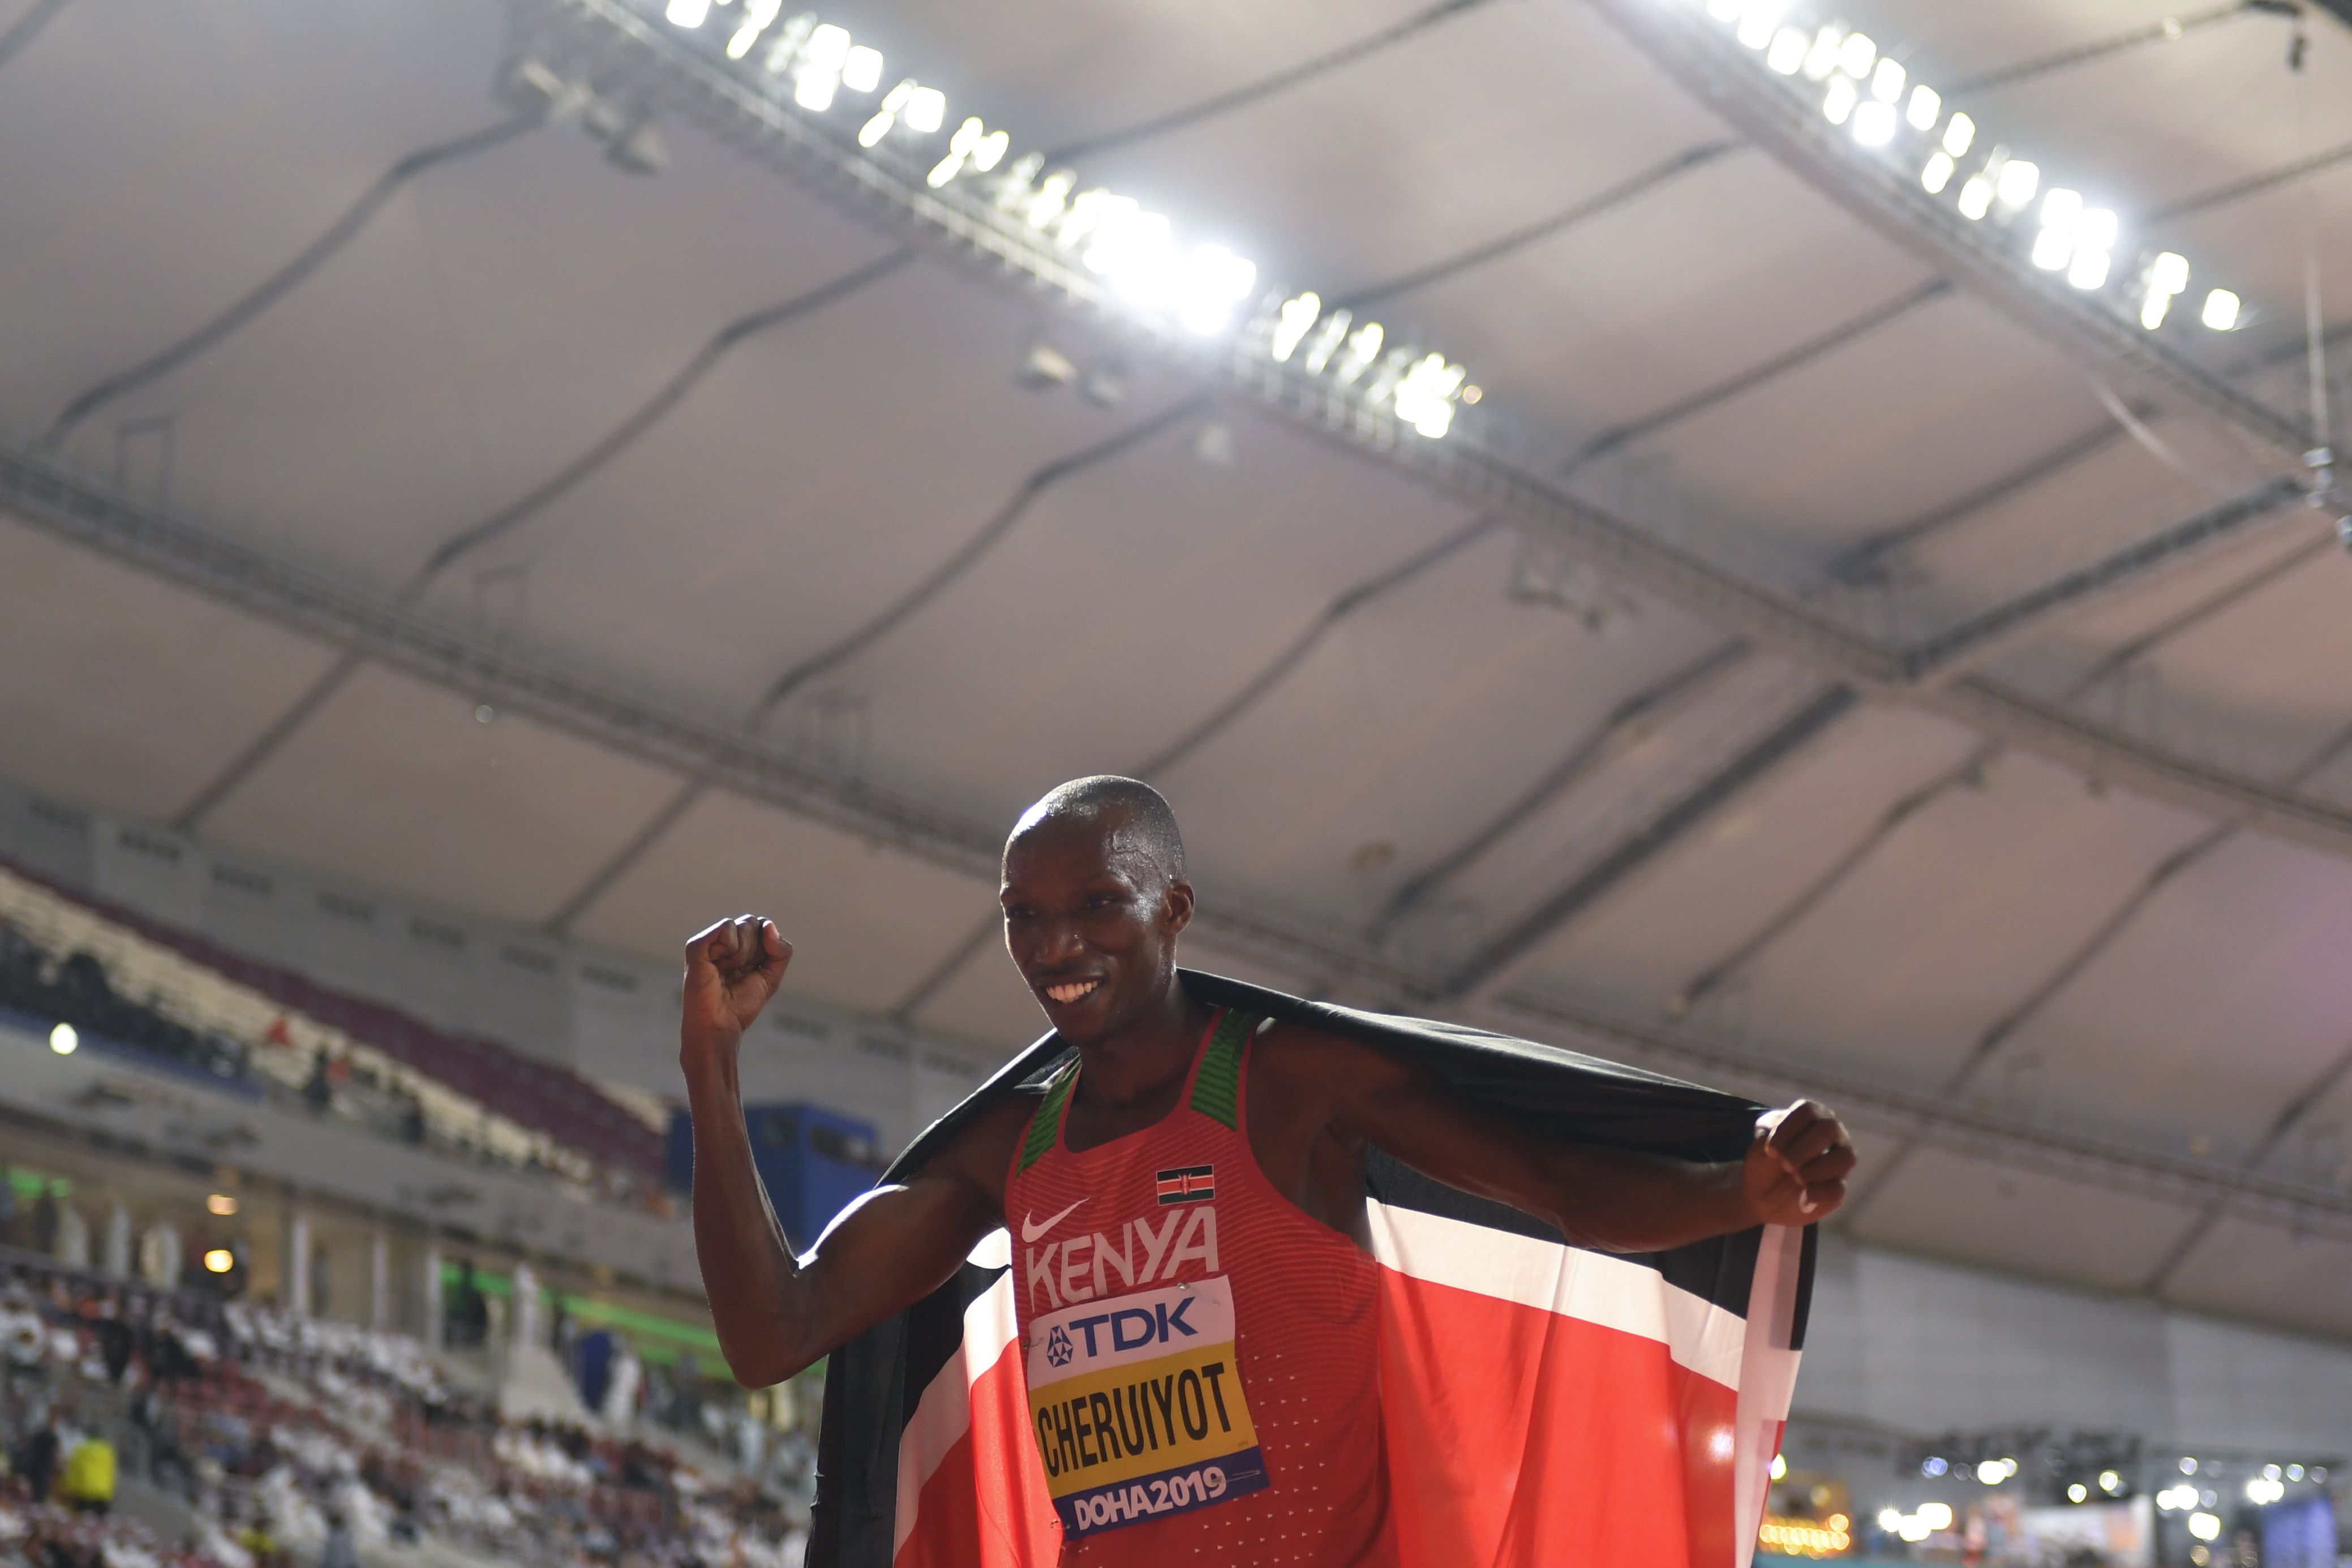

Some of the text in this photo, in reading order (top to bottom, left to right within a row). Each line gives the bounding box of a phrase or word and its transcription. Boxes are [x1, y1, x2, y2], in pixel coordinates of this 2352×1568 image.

[1026, 1206, 1219, 1313] KENYA
[1068, 1296, 1198, 1357] TDK
[1038, 1362, 1231, 1477] CHERUIYOT
[1074, 1467, 1227, 1531] DOHA2019
